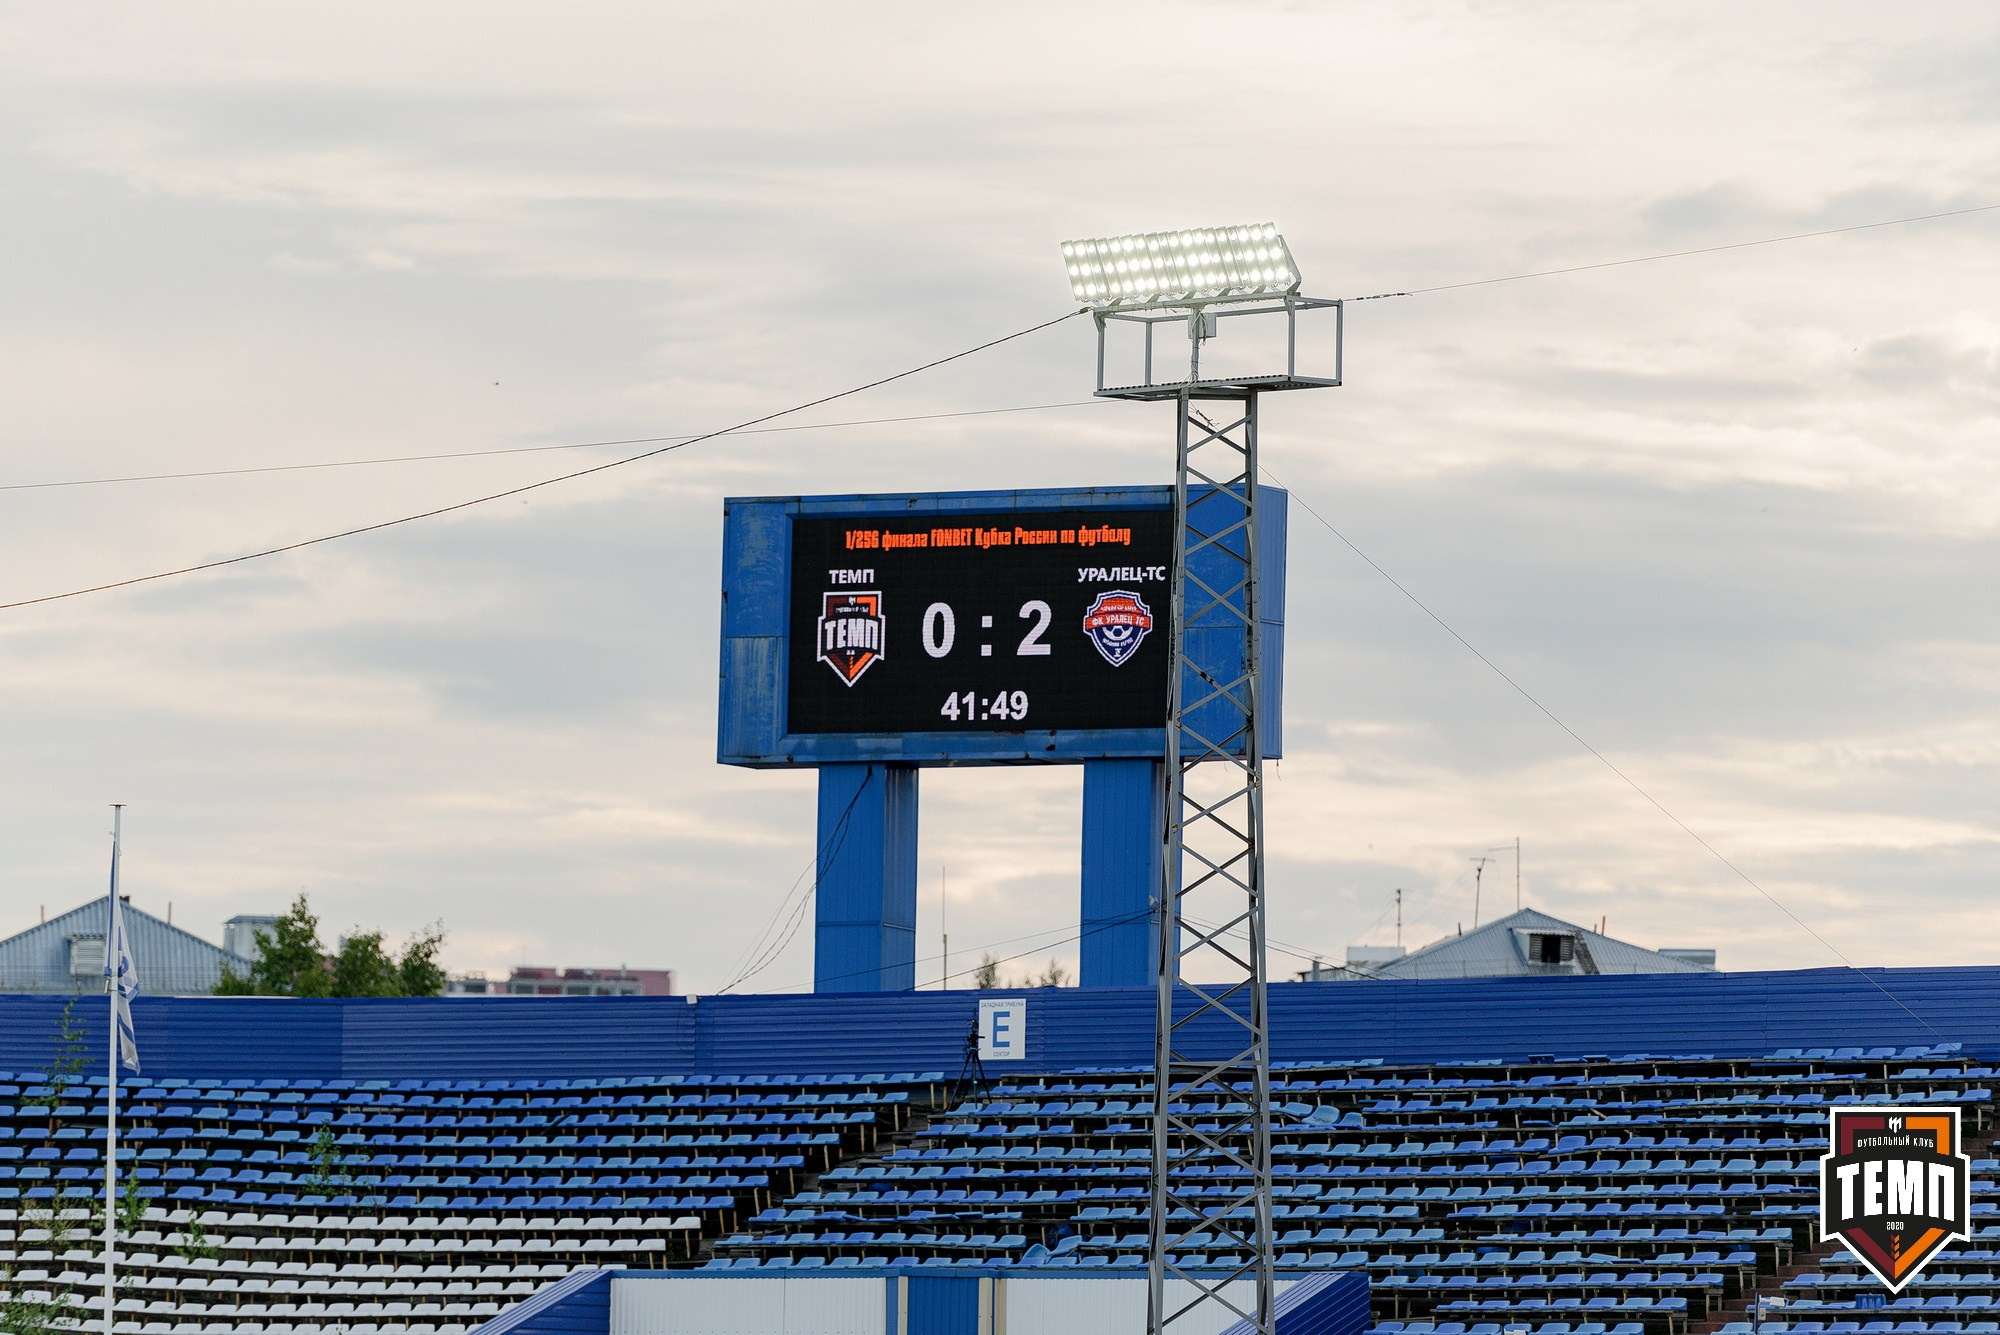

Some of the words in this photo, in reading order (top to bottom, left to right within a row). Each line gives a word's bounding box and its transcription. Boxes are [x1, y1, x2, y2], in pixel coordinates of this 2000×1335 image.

[846, 530, 879, 550] 1/256
[882, 530, 928, 551] финала
[930, 528, 973, 547] FONBET
[975, 527, 1011, 549] Кубка
[1014, 526, 1057, 545] России
[1060, 529, 1075, 544] по
[1078, 524, 1131, 547] футболу
[828, 568, 875, 584] ТЕМП
[1077, 566, 1166, 584] УРАЛЕЦ-ТС
[824, 618, 879, 651] ТЕМП
[922, 602, 956, 658] 0
[1016, 600, 1052, 656] 2
[940, 690, 1029, 721] 41:49
